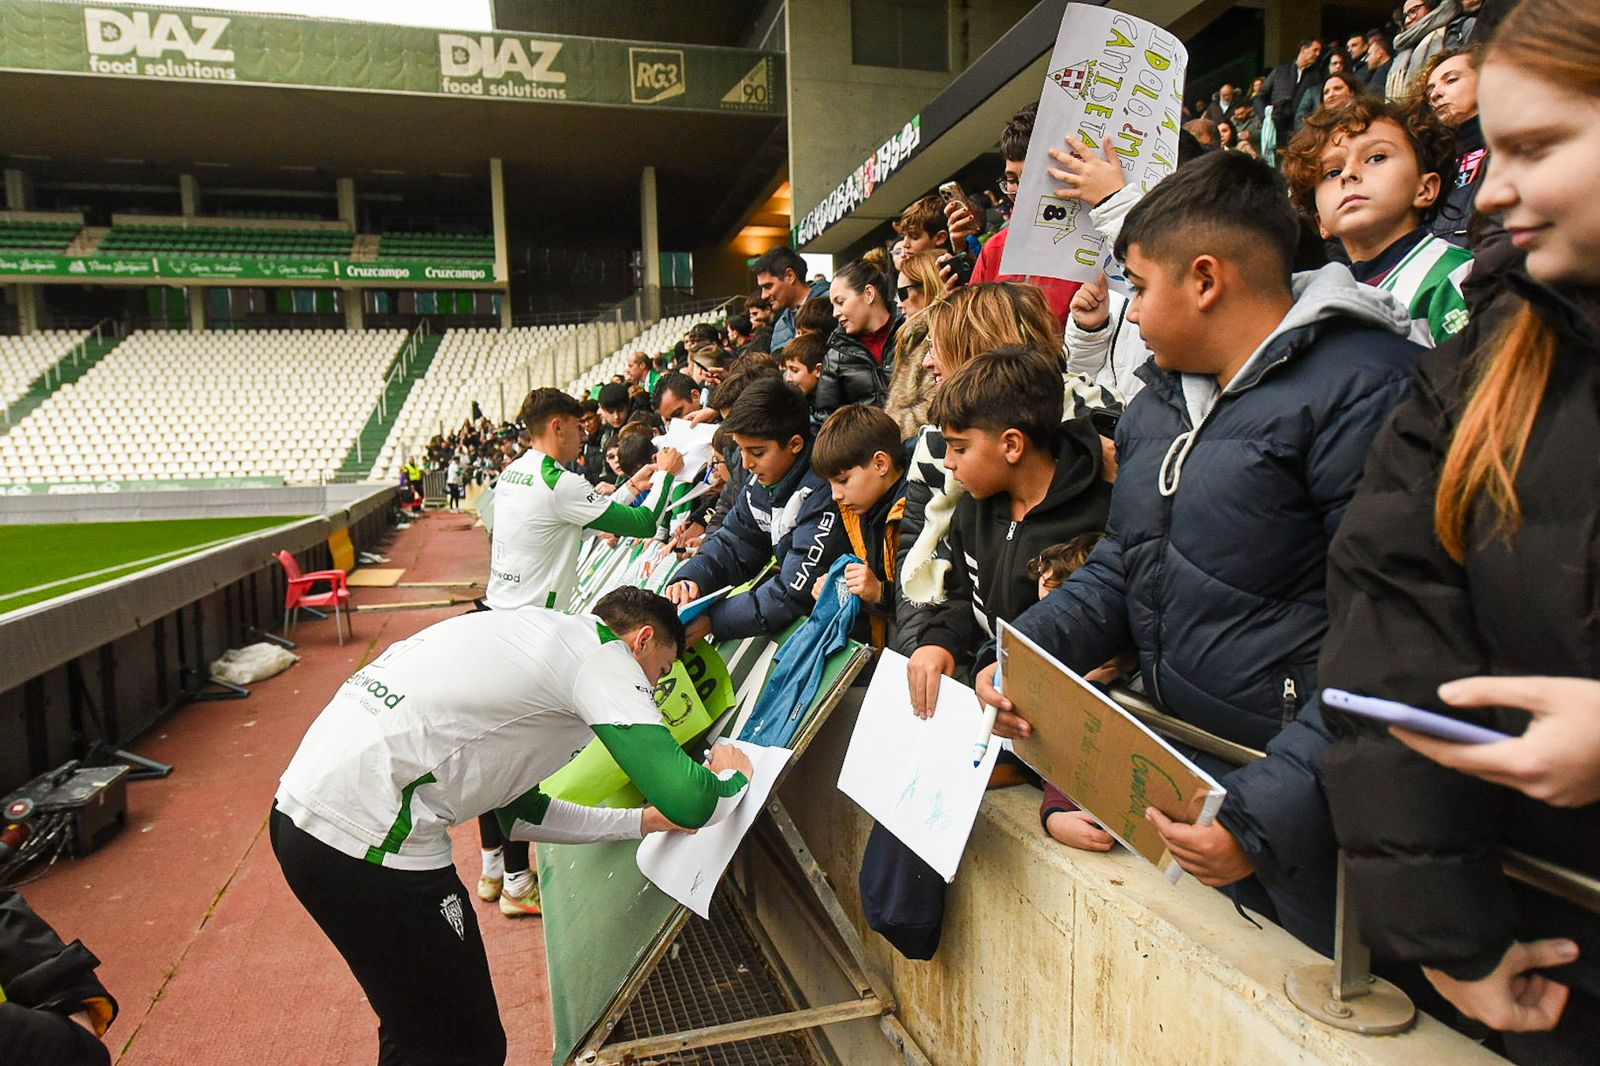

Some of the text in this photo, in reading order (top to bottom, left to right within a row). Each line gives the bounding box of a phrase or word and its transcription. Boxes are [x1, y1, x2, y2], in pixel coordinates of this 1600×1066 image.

[84, 8, 235, 62] DIAZ
[89, 55, 236, 80] food solutions
[439, 33, 566, 83] DIAZ
[636, 62, 678, 89] RG3
[443, 77, 567, 99] food solutions
[743, 84, 767, 102] 90
[1043, 204, 1067, 221] 8
[347, 265, 410, 279] Cruzcampo
[425, 266, 486, 280] Cruzcampo
[501, 470, 534, 487] oma
[790, 511, 835, 591] GIVOVA
